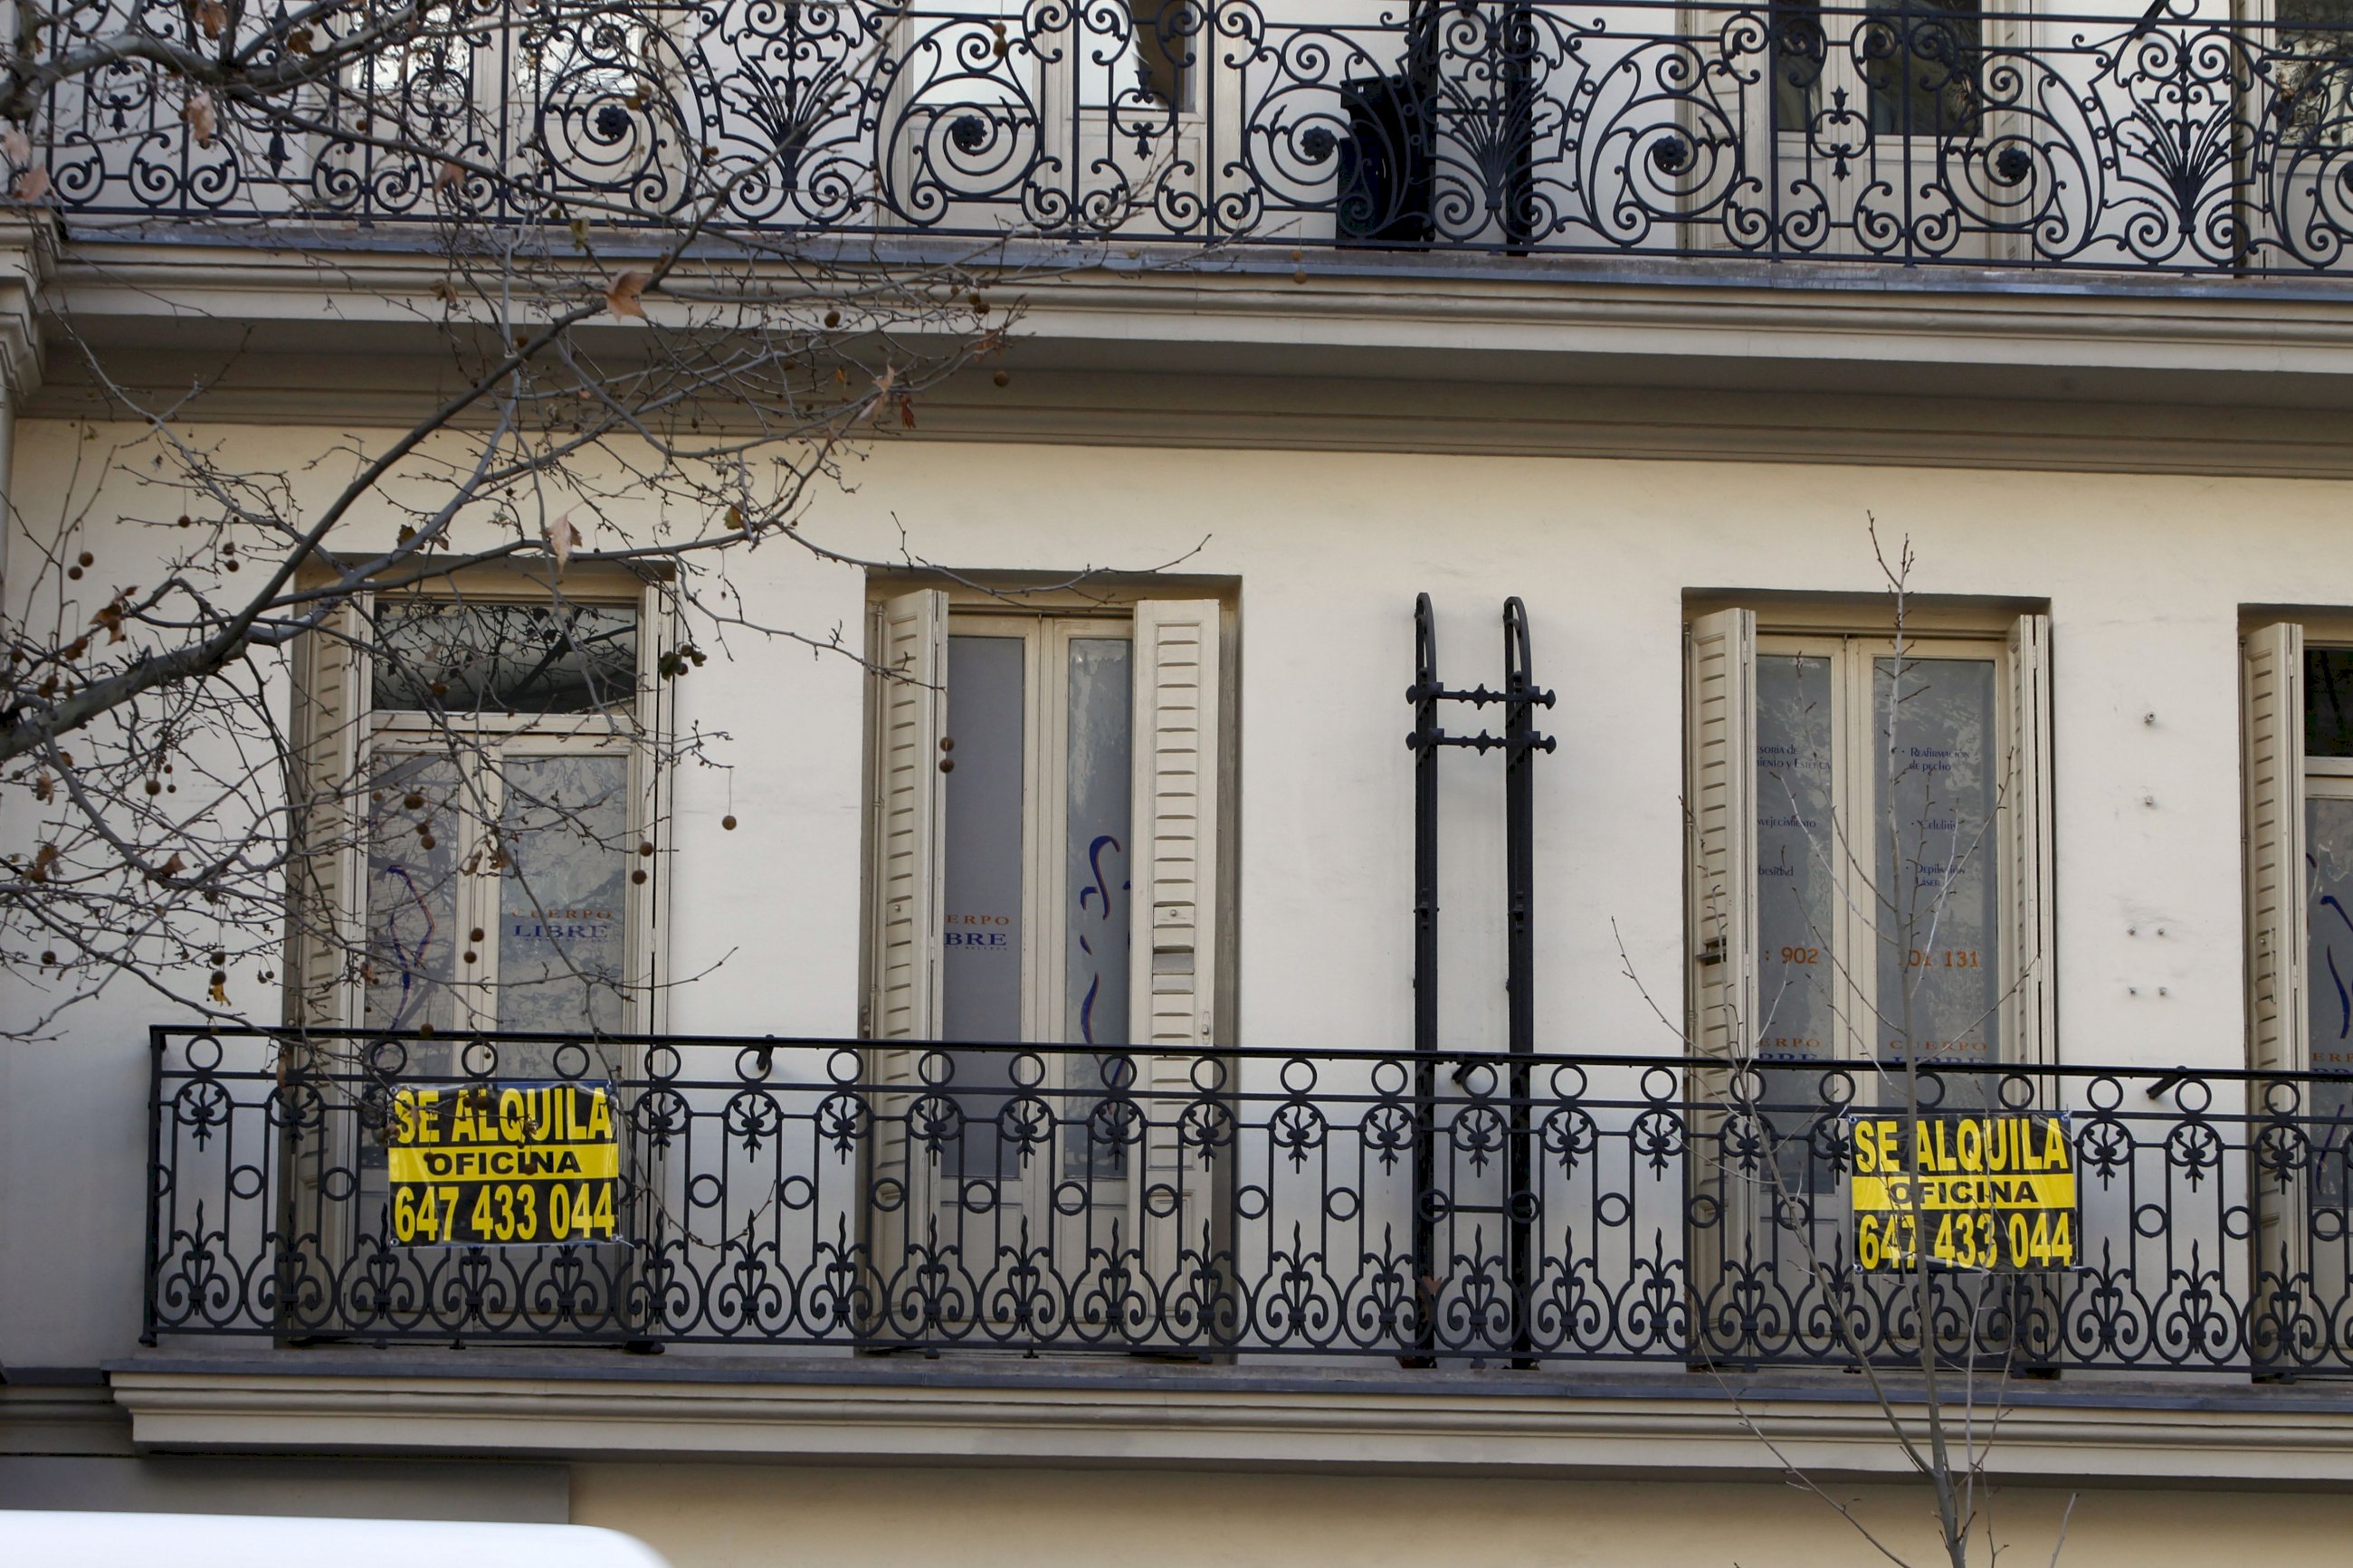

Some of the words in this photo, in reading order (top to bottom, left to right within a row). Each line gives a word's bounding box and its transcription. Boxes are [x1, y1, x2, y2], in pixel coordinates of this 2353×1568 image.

[512, 925, 609, 938] LIBRE
[1780, 947, 1819, 965] 902
[1897, 949, 1931, 966] 01
[1945, 950, 1979, 967] 131
[393, 1089, 440, 1144] SE
[451, 1087, 613, 1143] ALQUILA
[427, 1151, 582, 1175] OFICINA
[1855, 1120, 1900, 1173] SE
[1916, 1118, 2069, 1173] ALQUILA
[395, 1185, 459, 1242] 647
[472, 1184, 537, 1240] 433
[549, 1183, 615, 1240] 044
[1891, 1181, 2038, 1205] OFICINA
[1859, 1213, 1917, 1269] 647
[1934, 1213, 1997, 1269] 433
[2009, 1212, 2072, 1268] 044
